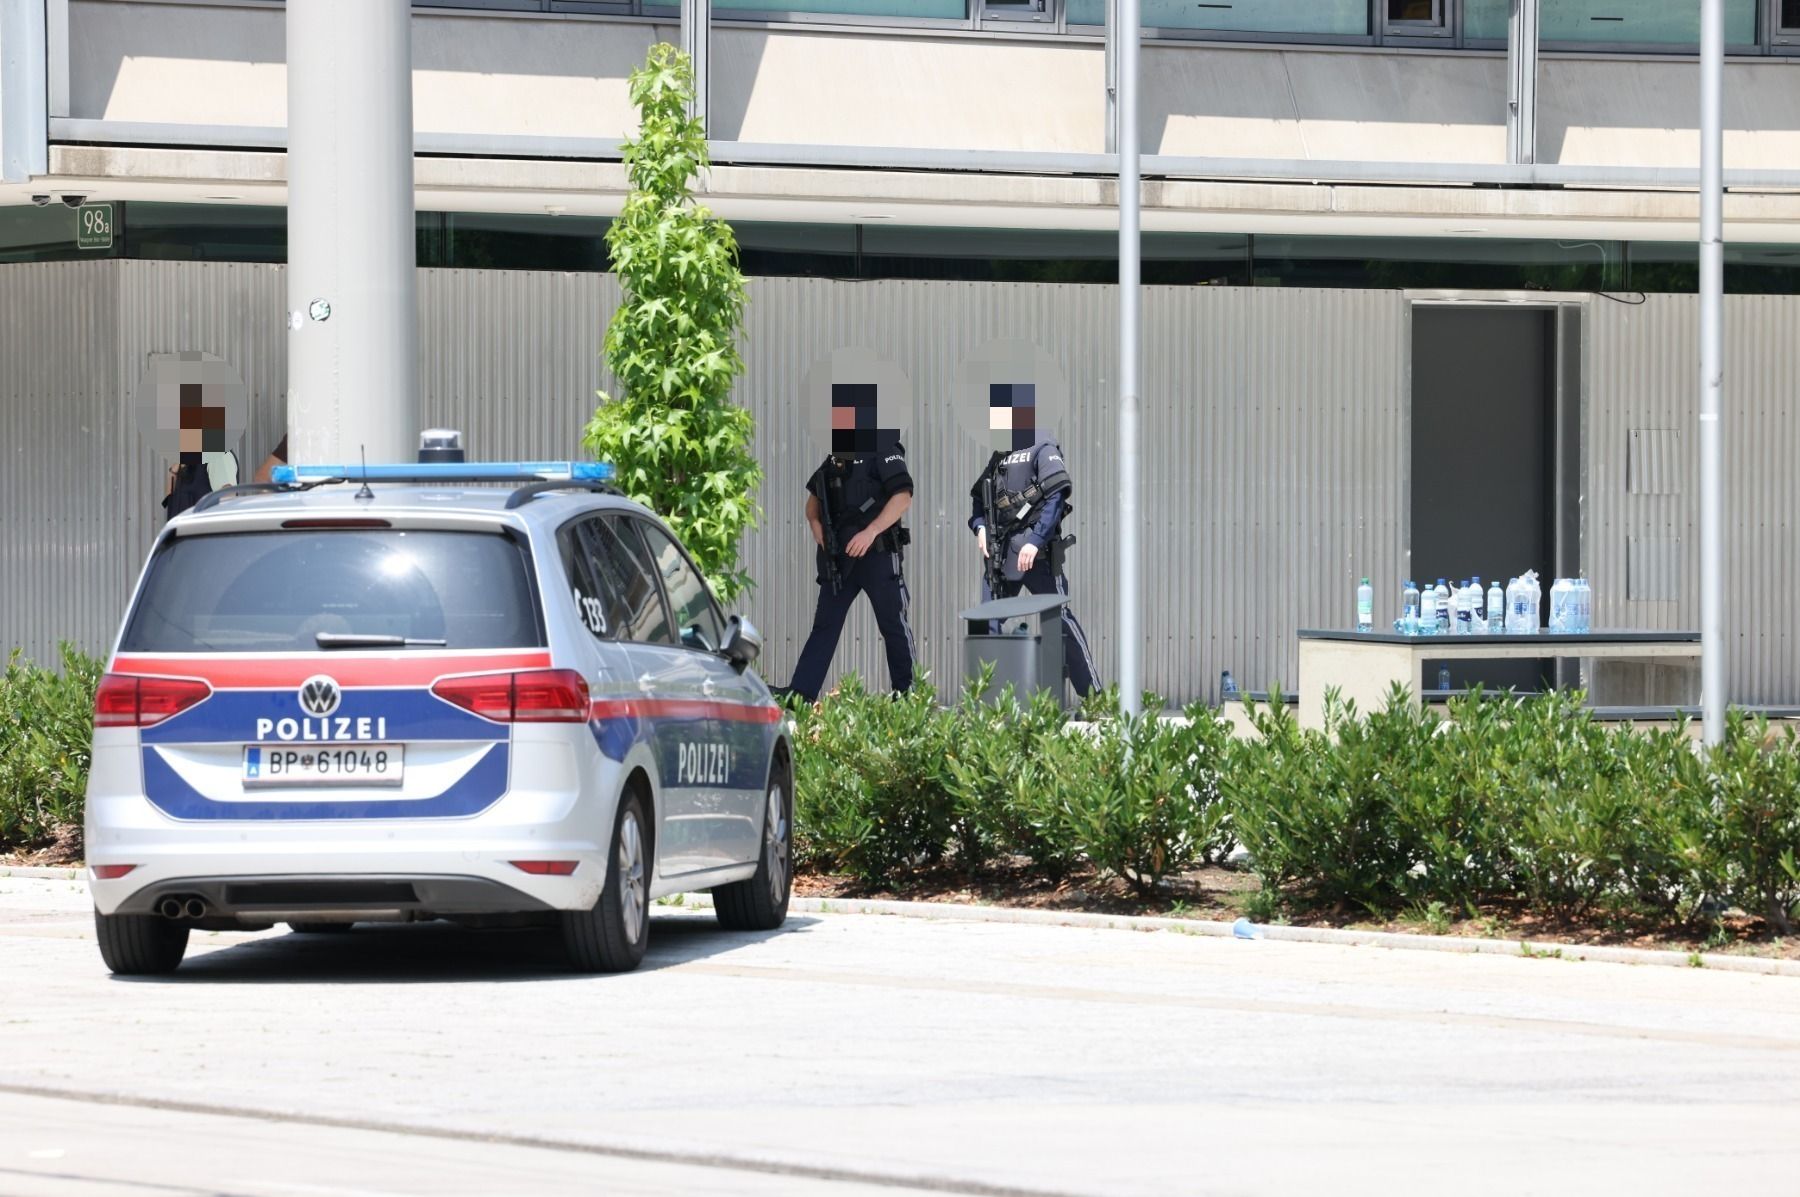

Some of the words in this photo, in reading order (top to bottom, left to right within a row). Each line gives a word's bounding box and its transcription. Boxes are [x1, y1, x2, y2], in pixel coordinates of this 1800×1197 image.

[84, 210, 110, 234] 98a
[999, 452, 1031, 465] LIZEI
[582, 597, 607, 633] 133
[300, 678, 340, 716] VW
[256, 717, 386, 741] POLIZEI
[270, 752, 298, 774] BP
[317, 751, 388, 774] 61048
[678, 742, 729, 784] POLIZEI
